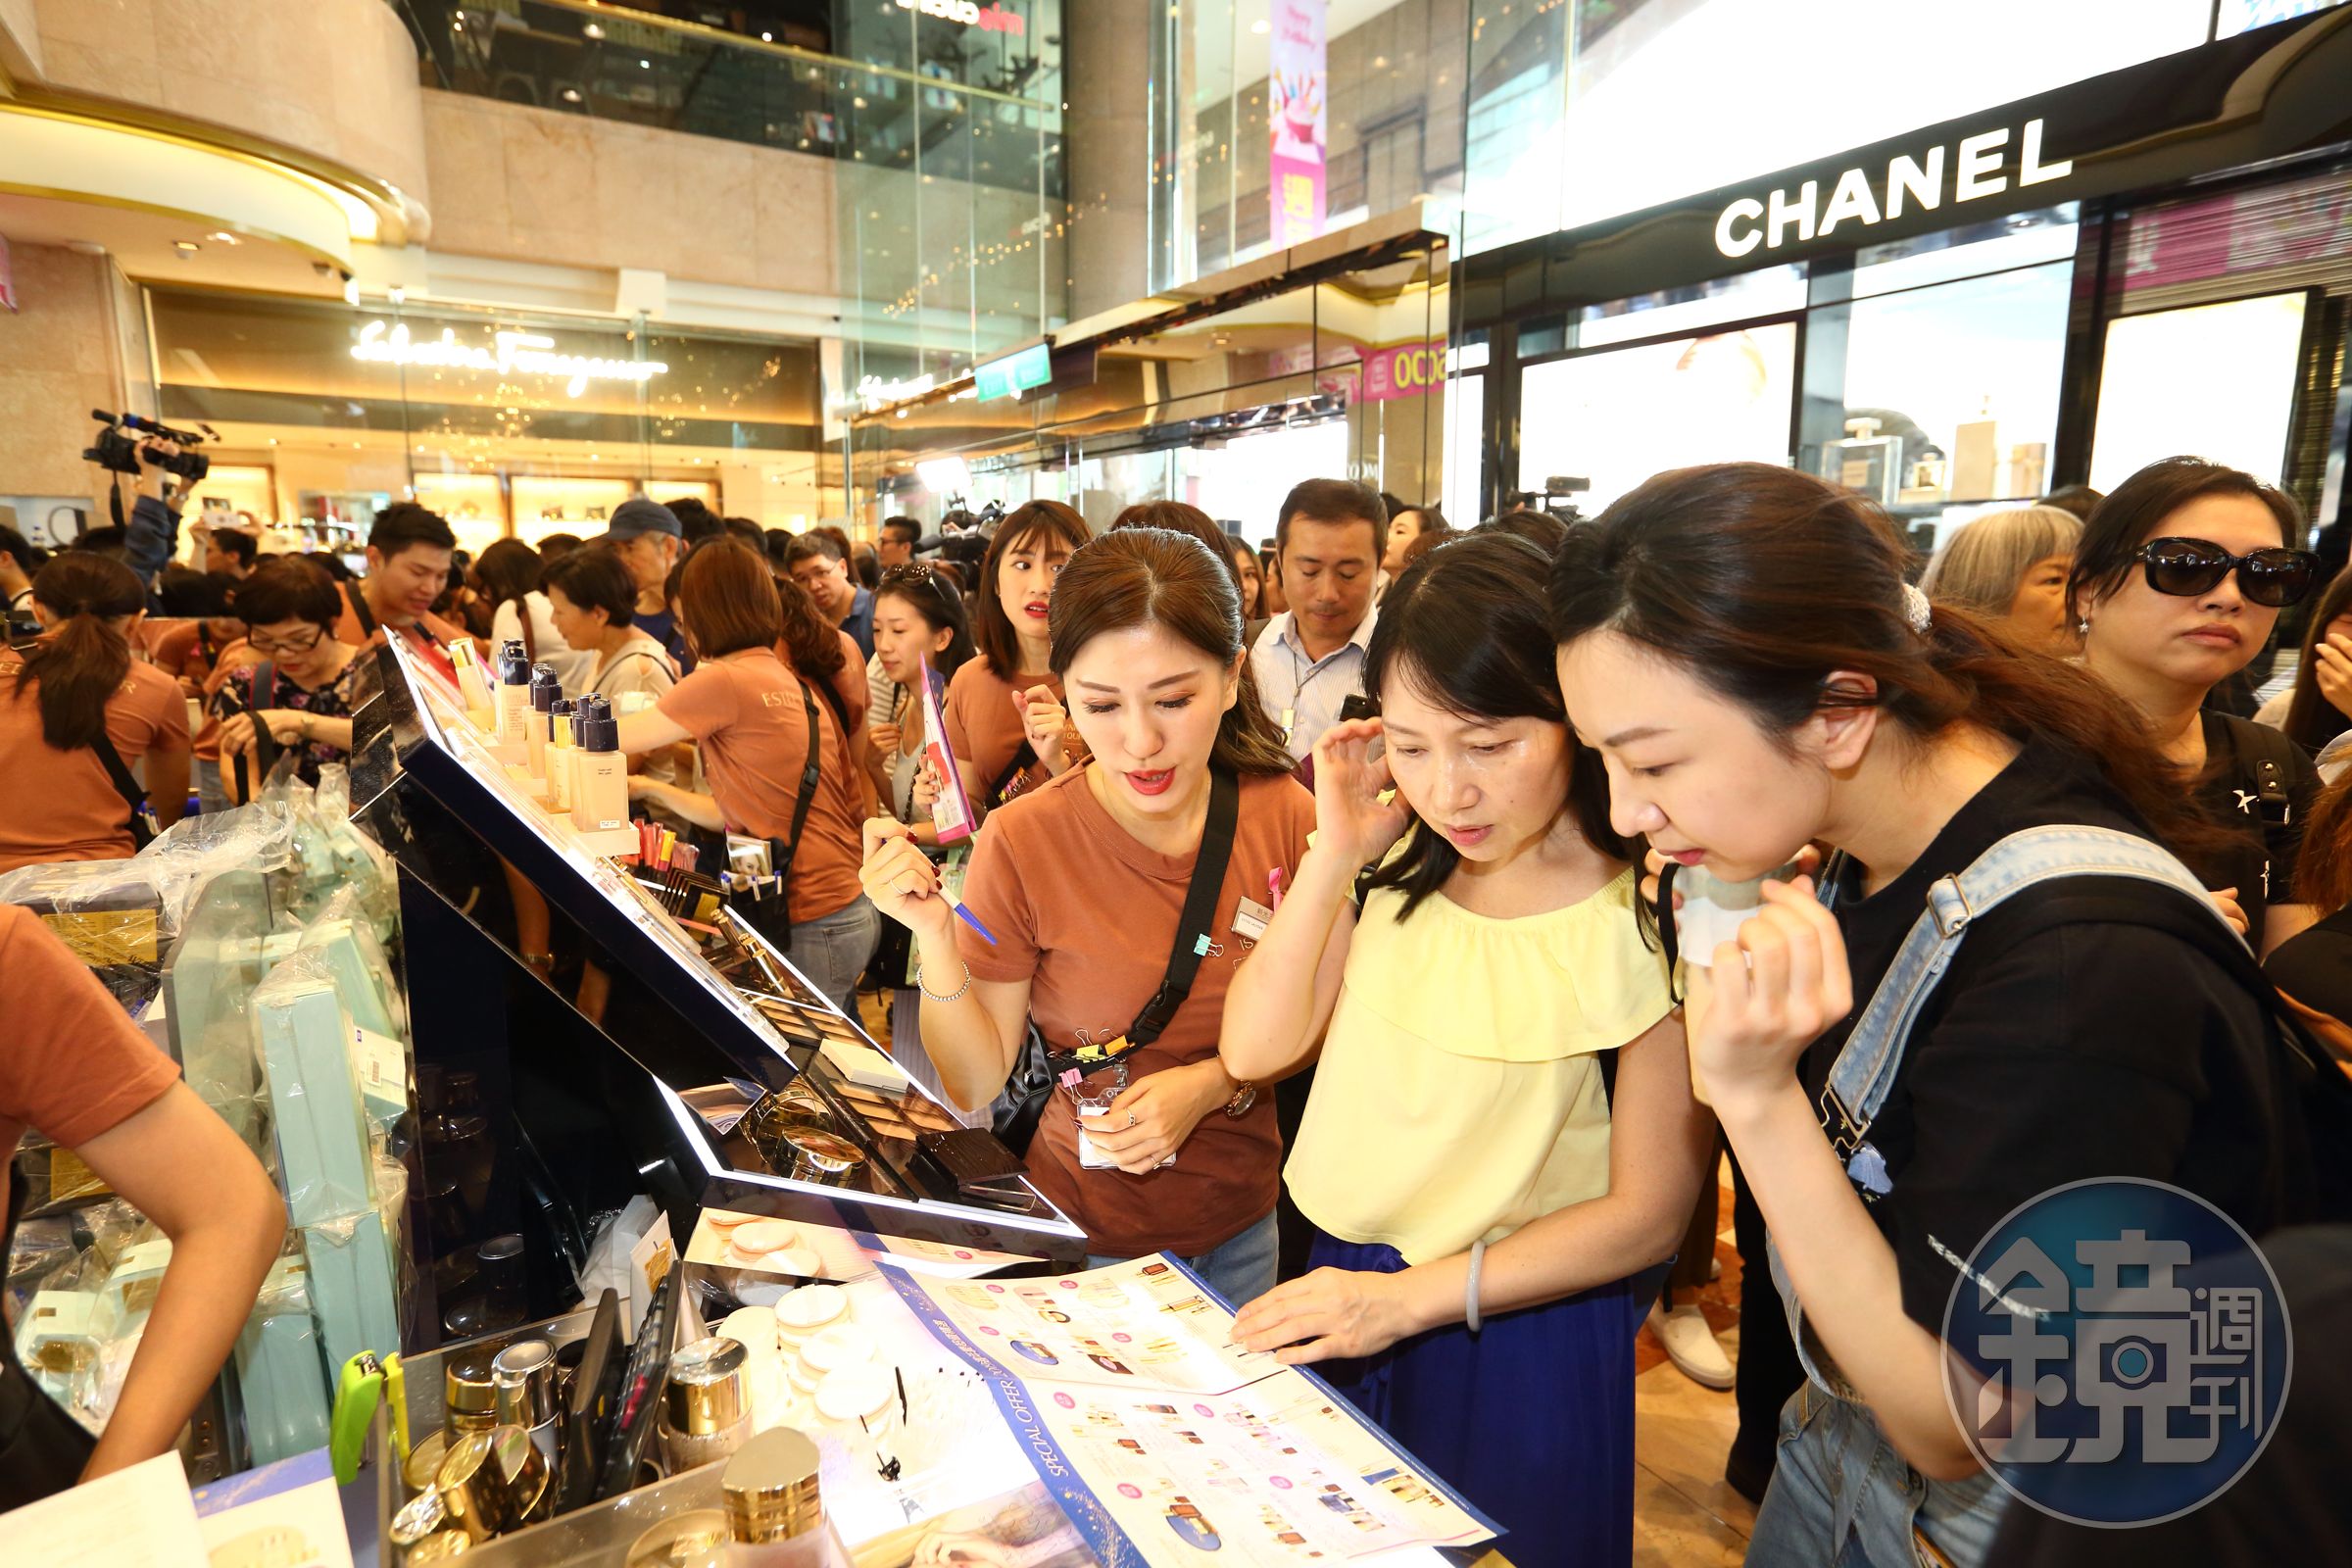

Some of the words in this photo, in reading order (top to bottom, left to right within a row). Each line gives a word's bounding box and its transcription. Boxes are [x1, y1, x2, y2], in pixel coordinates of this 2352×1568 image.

[1715, 119, 2073, 258] CHANEL
[1000, 1379, 1033, 1423] OFFER
[1024, 1425, 1069, 1478] SPECIAL
